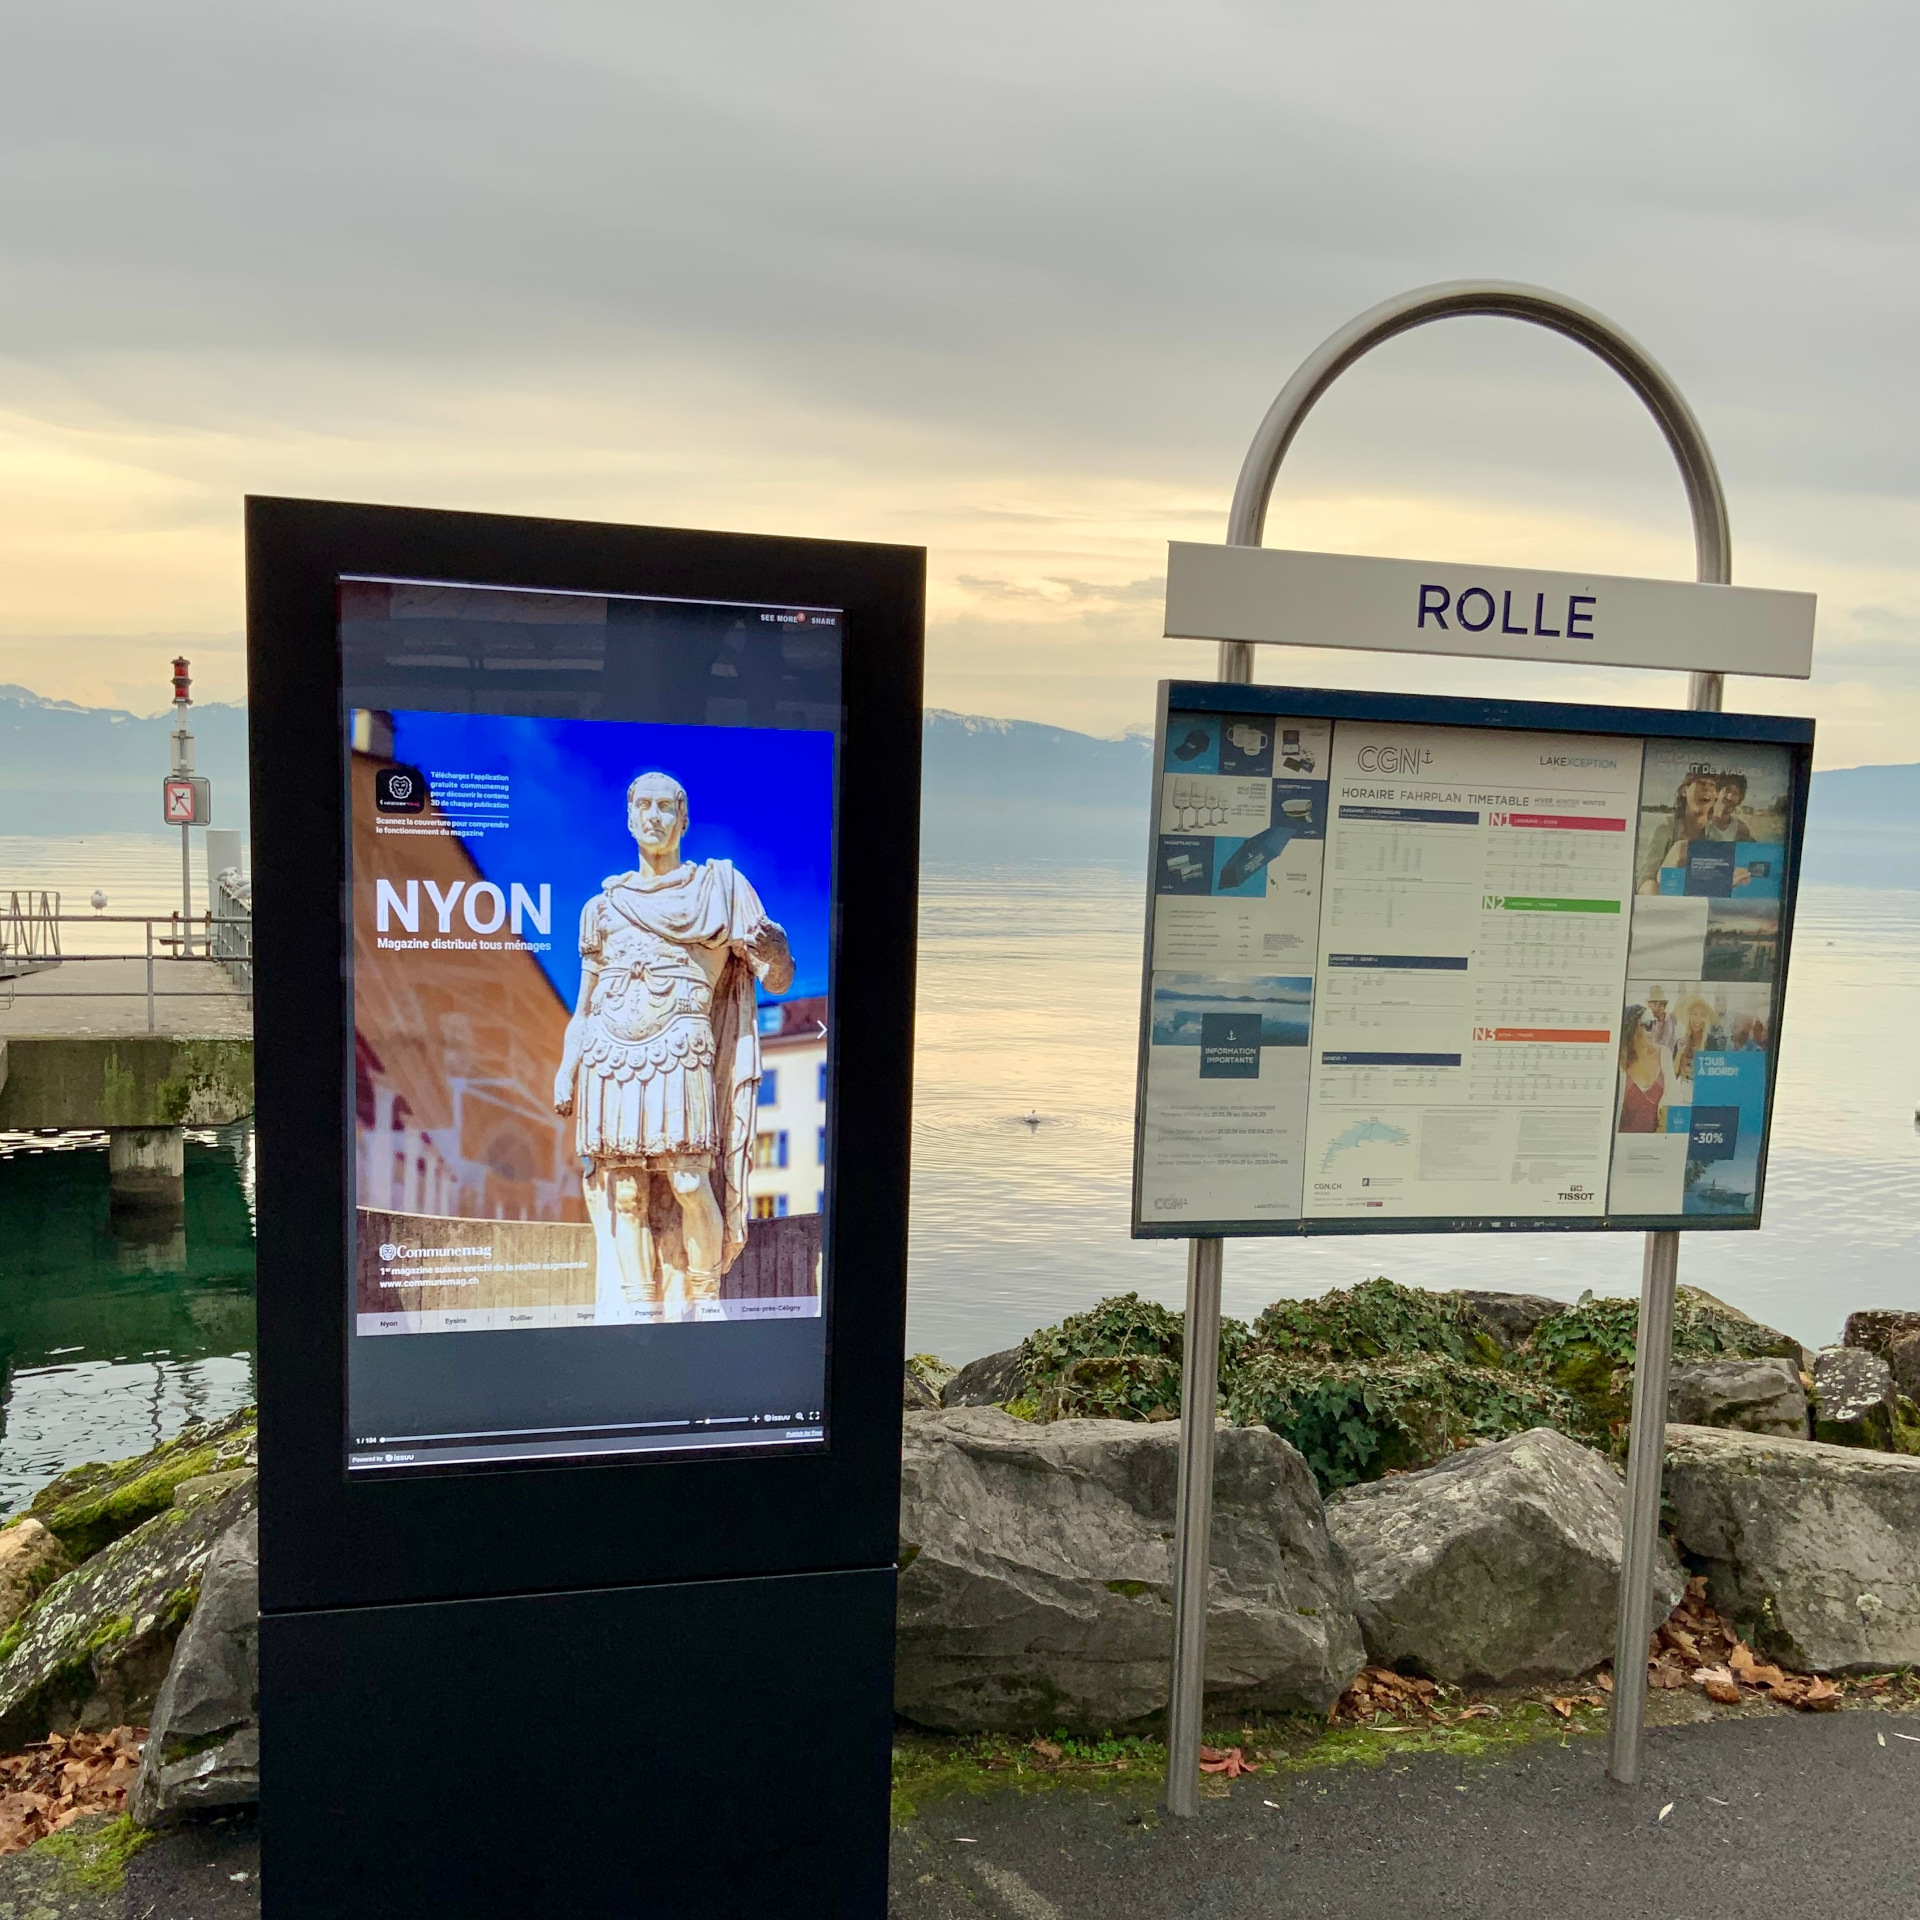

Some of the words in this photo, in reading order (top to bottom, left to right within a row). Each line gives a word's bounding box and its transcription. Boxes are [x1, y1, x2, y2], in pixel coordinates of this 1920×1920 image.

[1418, 584, 1597, 640] ROLLE
[760, 614, 774, 622] SEE
[776, 614, 798, 623] MORE
[811, 618, 836, 626] SHARE
[1357, 745, 1421, 775] CGN
[1540, 755, 1617, 769] LAKEXCEPTION
[430, 772, 470, 780] Téléchargez
[470, 773, 509, 782] l'application
[460, 782, 509, 791] communemag
[484, 792, 509, 800] contenu
[1342, 787, 1395, 800] HORAIRE
[1400, 790, 1462, 804] FAHRPLAN
[1467, 793, 1530, 807] TIMETABLE
[450, 800, 472, 808] chaque
[474, 800, 509, 808] publication
[376, 817, 406, 825] Scannez
[414, 819, 451, 827] couverture
[452, 820, 468, 828] pour
[468, 821, 509, 829] comprendre
[376, 826, 383, 834] le
[384, 826, 439, 835] fonctionnement
[451, 829, 484, 837] magazine
[376, 879, 551, 935] NYON
[1482, 896, 1506, 910] N2
[377, 938, 429, 951] Magazine
[431, 938, 478, 950] distribué
[479, 940, 503, 950] tous
[504, 940, 551, 952] ménages
[1472, 1027, 1496, 1041] N3
[1207, 1056, 1254, 1064] IMPORTANTE
[1698, 1057, 1725, 1066] TOUS
[1694, 1132, 1723, 1144] -30%
[1314, 1182, 1342, 1190] CGN.CH
[1557, 1192, 1595, 1201] TISSOT
[397, 1244, 493, 1259] Communemag
[391, 1266, 433, 1276] magazine
[435, 1265, 462, 1274] suisse
[464, 1264, 492, 1273] enrichi
[494, 1264, 505, 1272] de
[506, 1263, 514, 1272] la
[515, 1262, 541, 1271] réalité
[542, 1261, 588, 1271] augmentée
[380, 1276, 479, 1289] www.communemag.ch
[380, 1320, 398, 1328] Nyon
[577, 1312, 595, 1321] Signy
[635, 1310, 663, 1318] Prangins
[742, 1304, 801, 1313] Crans-près-Céligny
